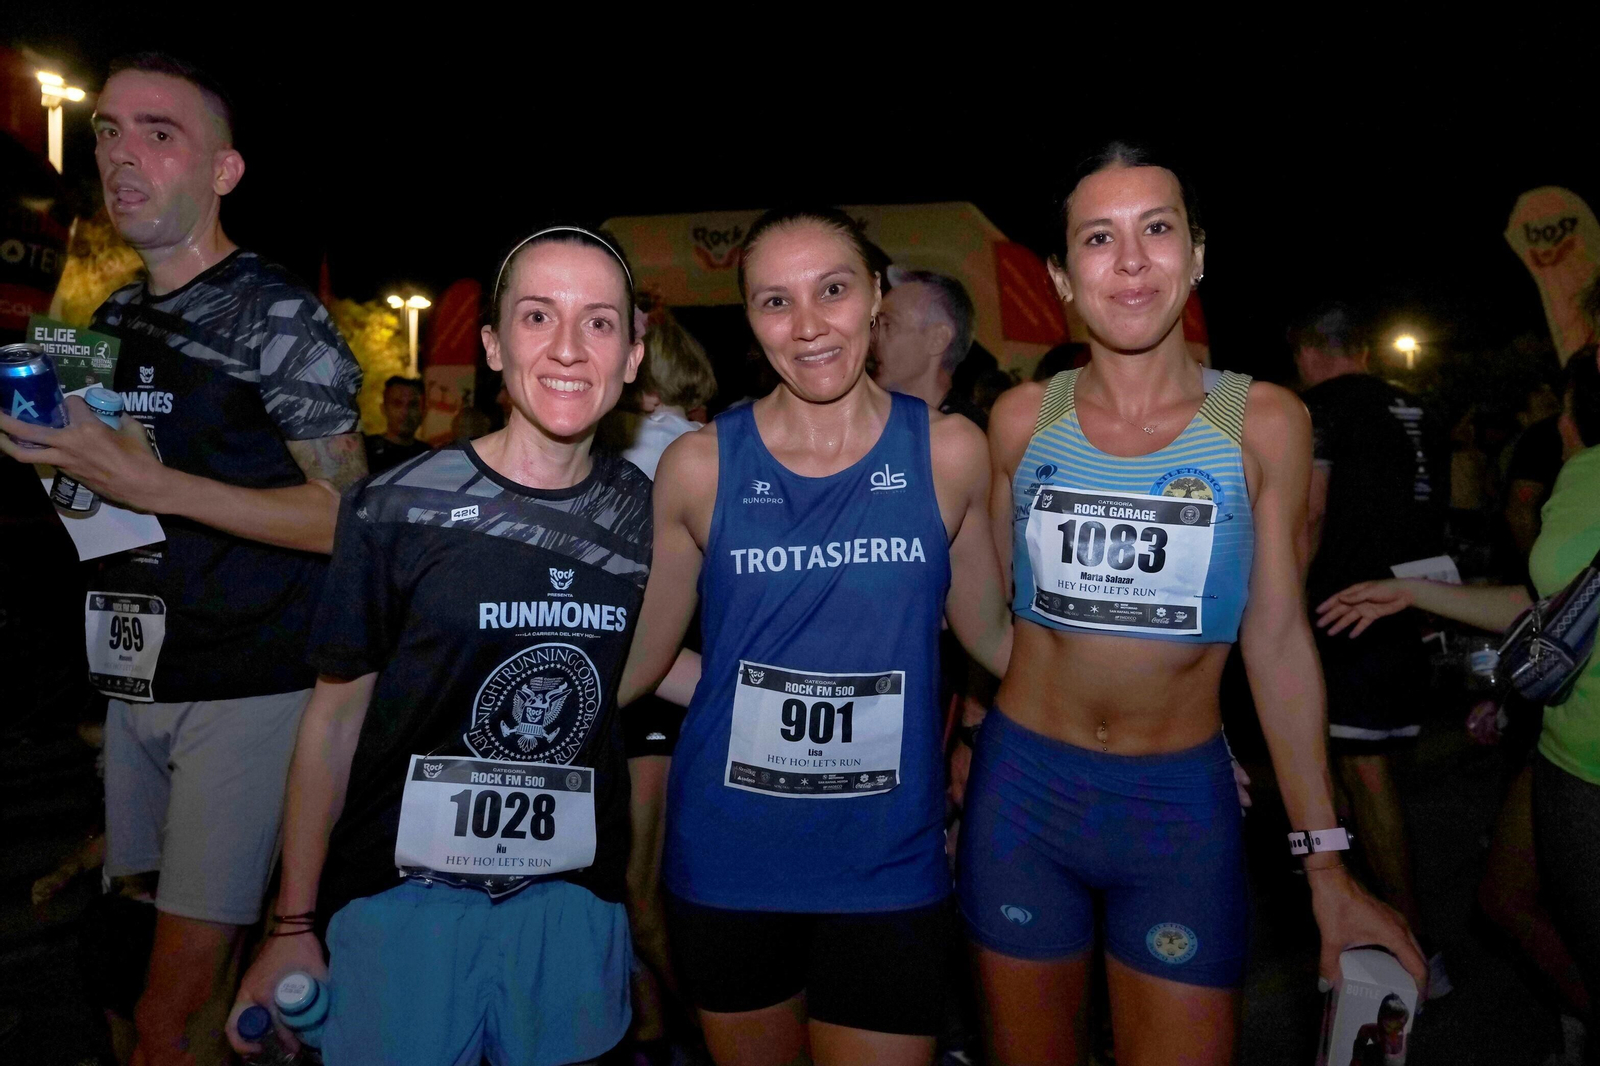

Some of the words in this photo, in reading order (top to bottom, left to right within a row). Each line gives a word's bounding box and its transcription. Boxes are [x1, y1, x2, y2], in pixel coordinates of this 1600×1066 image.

[34, 327, 77, 343] ELIGE
[870, 464, 907, 491] als
[1156, 468, 1221, 492] ATLETISMO
[1073, 503, 1106, 516] ROCK
[1109, 507, 1157, 520] GARAGE
[1058, 520, 1168, 574] 1083
[730, 537, 926, 575] TROTASIERRA
[549, 567, 575, 581] Rock
[1105, 574, 1134, 585] Salazar
[1058, 580, 1077, 591] HEY
[1079, 583, 1101, 593] HO!
[1103, 585, 1130, 596] LET'S
[1132, 588, 1157, 597] RUN
[479, 601, 628, 632] RUNMONES
[109, 615, 144, 652] 959
[785, 682, 814, 695] ROCK
[816, 685, 832, 697] FM
[835, 686, 855, 696] 500
[781, 698, 855, 745] 901
[469, 729, 494, 751] HEY
[553, 738, 581, 765] RUN
[808, 748, 823, 757] Lisa
[767, 754, 787, 765] HEY
[789, 757, 810, 767] HO!
[813, 759, 837, 768] LET'S
[840, 758, 862, 767] RUN
[470, 771, 502, 785] ROCK
[505, 773, 521, 786] FM
[525, 775, 545, 788] 500
[450, 789, 556, 841] 1028
[496, 843, 507, 854] Ñu
[446, 856, 471, 866] HEY
[473, 857, 495, 867] HO!
[498, 857, 525, 868] LET'S
[528, 858, 552, 869] RUN
